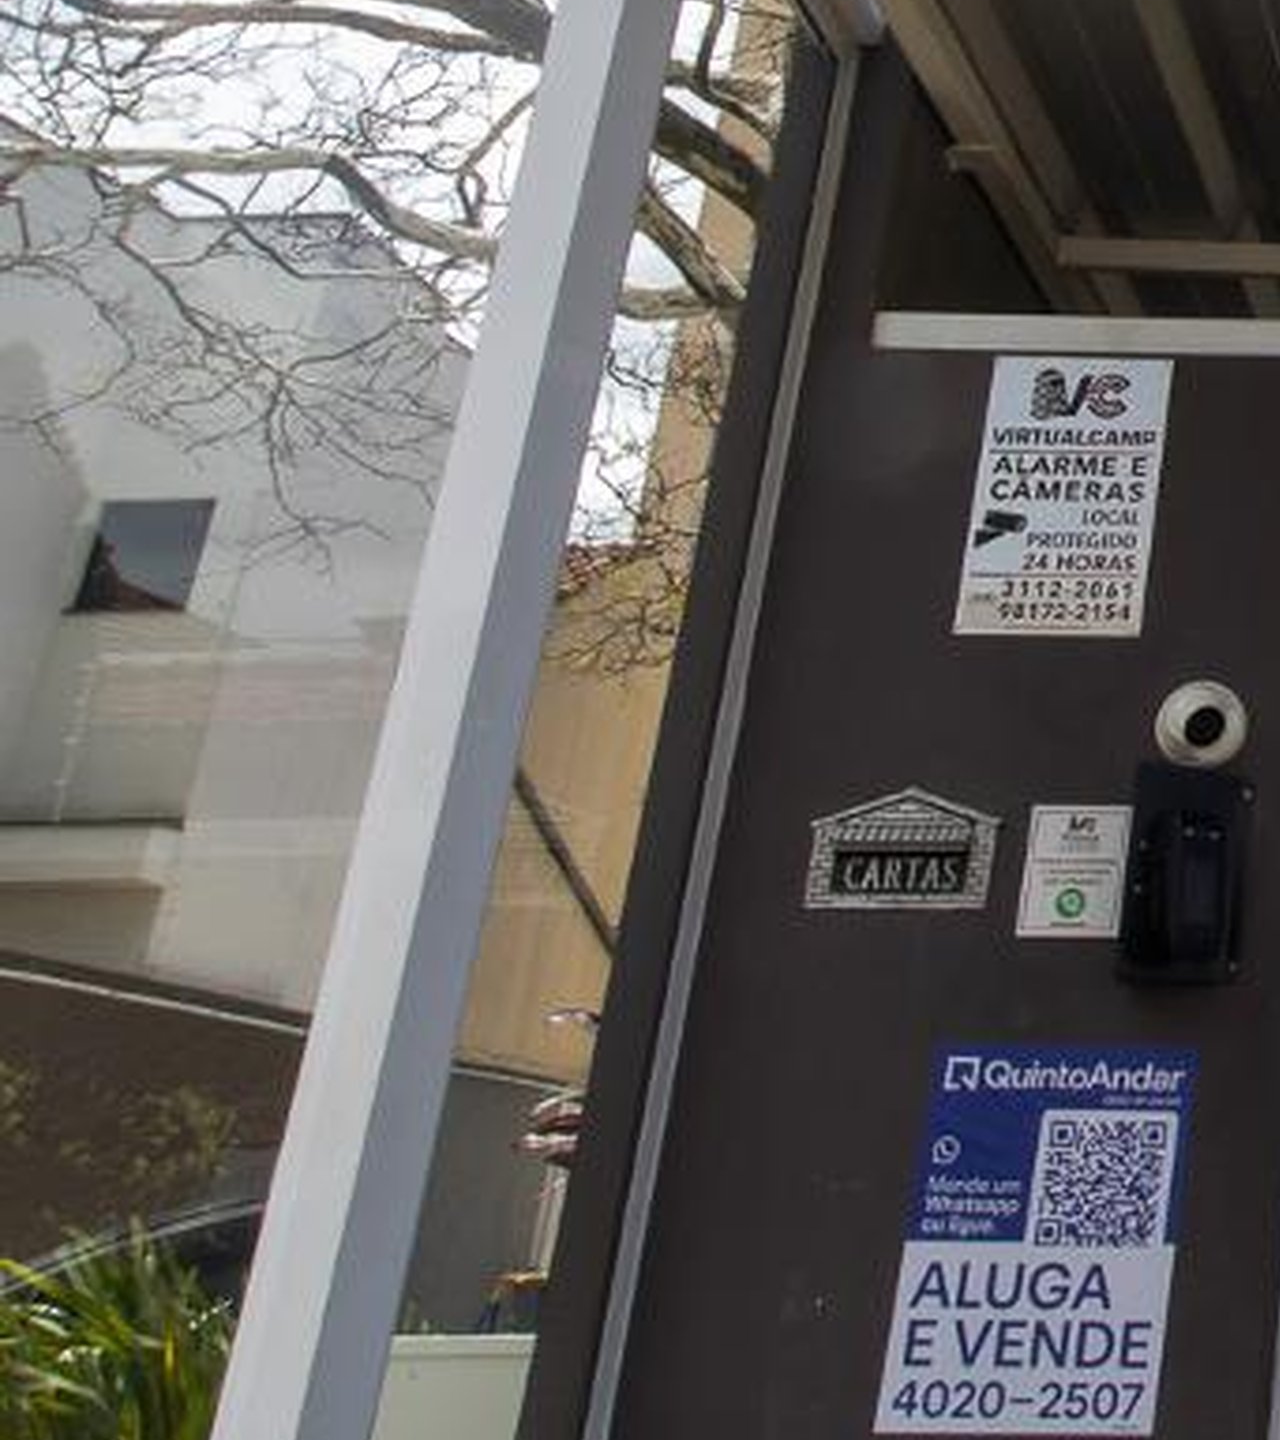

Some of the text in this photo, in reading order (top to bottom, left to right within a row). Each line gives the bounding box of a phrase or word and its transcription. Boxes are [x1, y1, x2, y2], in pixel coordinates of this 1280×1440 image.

[993, 455, 1147, 477] ALARME E
[1082, 509, 1140, 527] LOCAL
[1026, 532, 1138, 550] PROTEGIDO
[1022, 553, 1136, 572] 24 HORAS
[843, 855, 959, 892] CARTAS
[984, 1058, 1186, 1093] QuintoAndar
[908, 1260, 1112, 1311] ALUGA
[903, 1319, 1152, 1369] E VENDE
[891, 1380, 1146, 1421] 4020-2507
